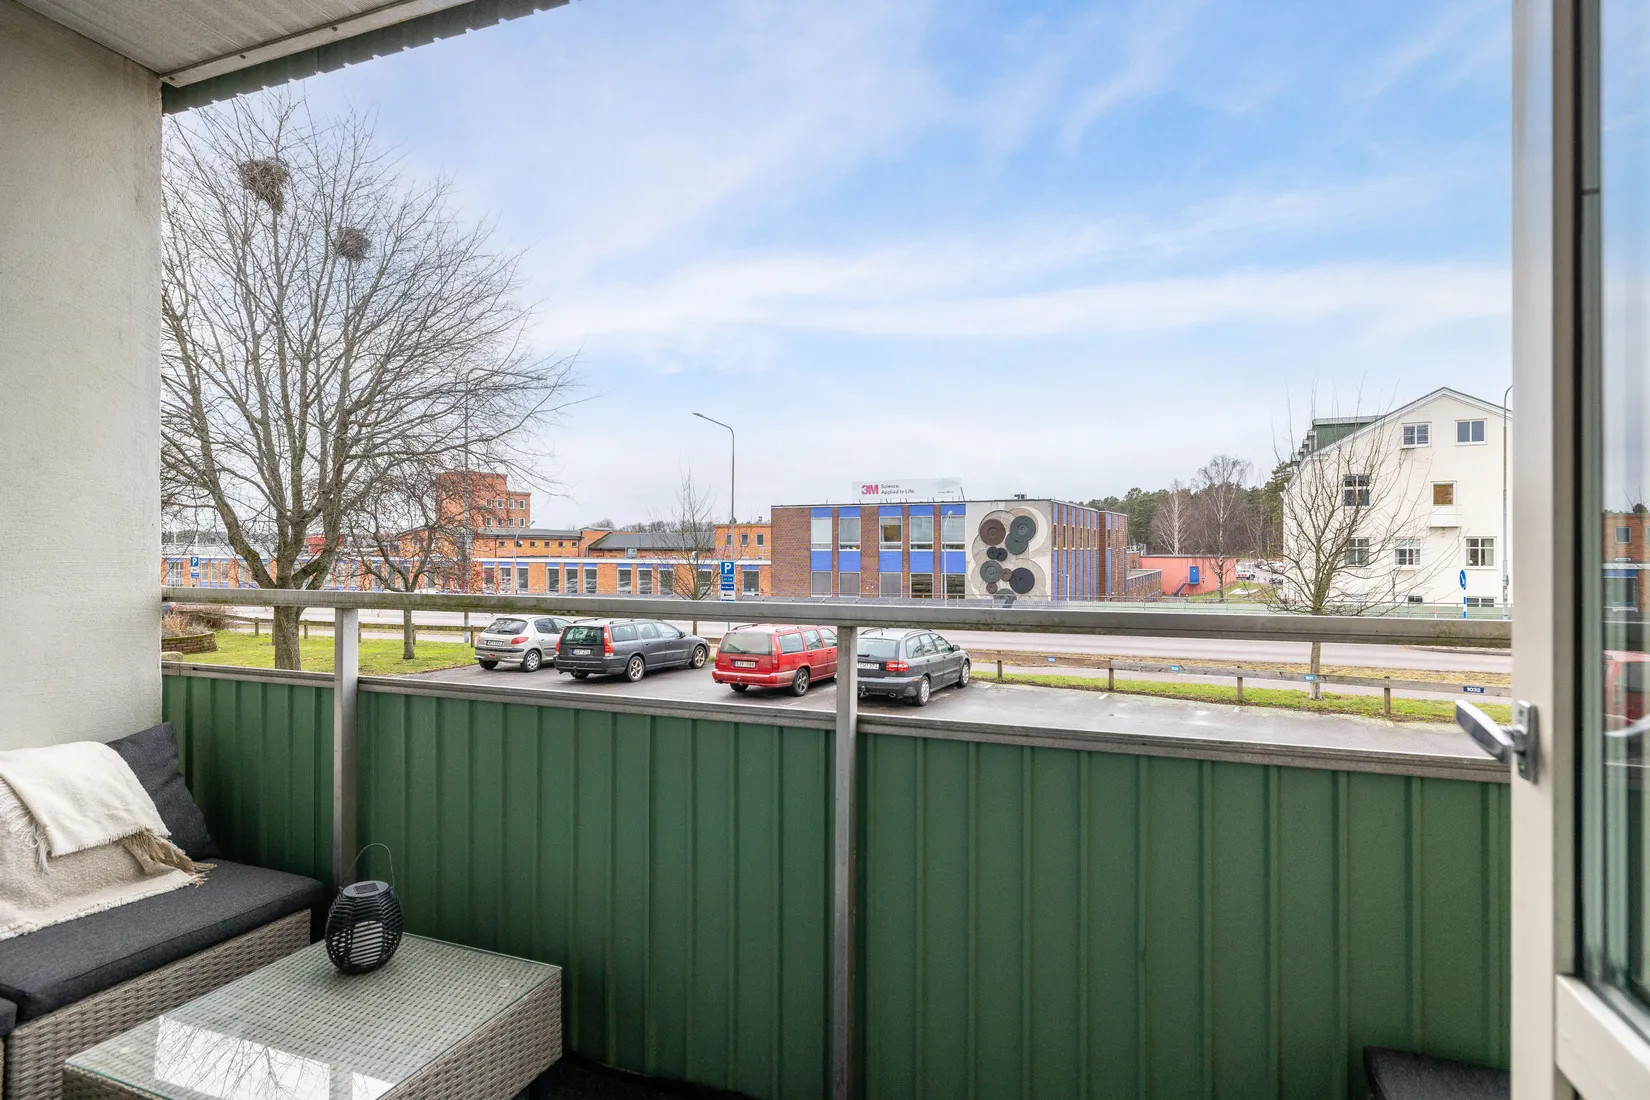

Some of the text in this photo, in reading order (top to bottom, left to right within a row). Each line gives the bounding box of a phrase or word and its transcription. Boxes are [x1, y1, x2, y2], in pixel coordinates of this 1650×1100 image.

[861, 484, 879, 495] 3M
[193, 557, 198, 566] P
[724, 562, 732, 574] P
